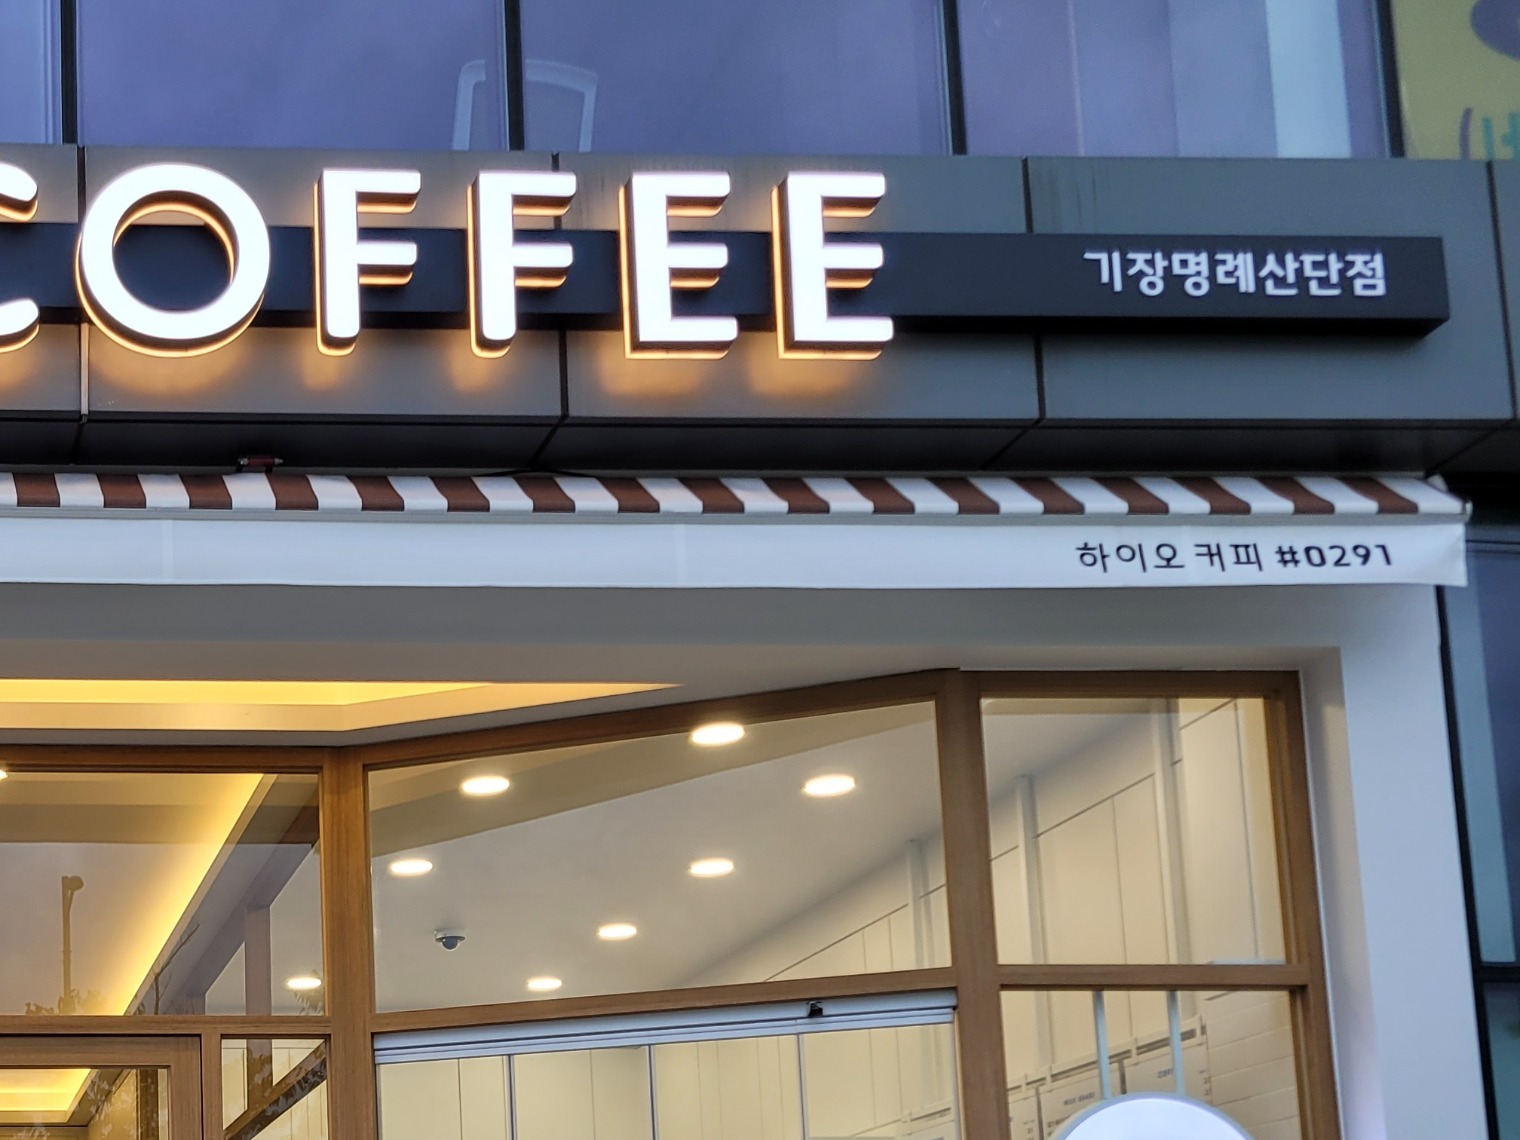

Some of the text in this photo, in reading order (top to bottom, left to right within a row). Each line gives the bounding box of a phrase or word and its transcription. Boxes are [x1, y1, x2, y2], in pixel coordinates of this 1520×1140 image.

[1083, 249, 1387, 298] 기장명례산단점
[1075, 541, 1393, 575] 하이오 커피 #0291
